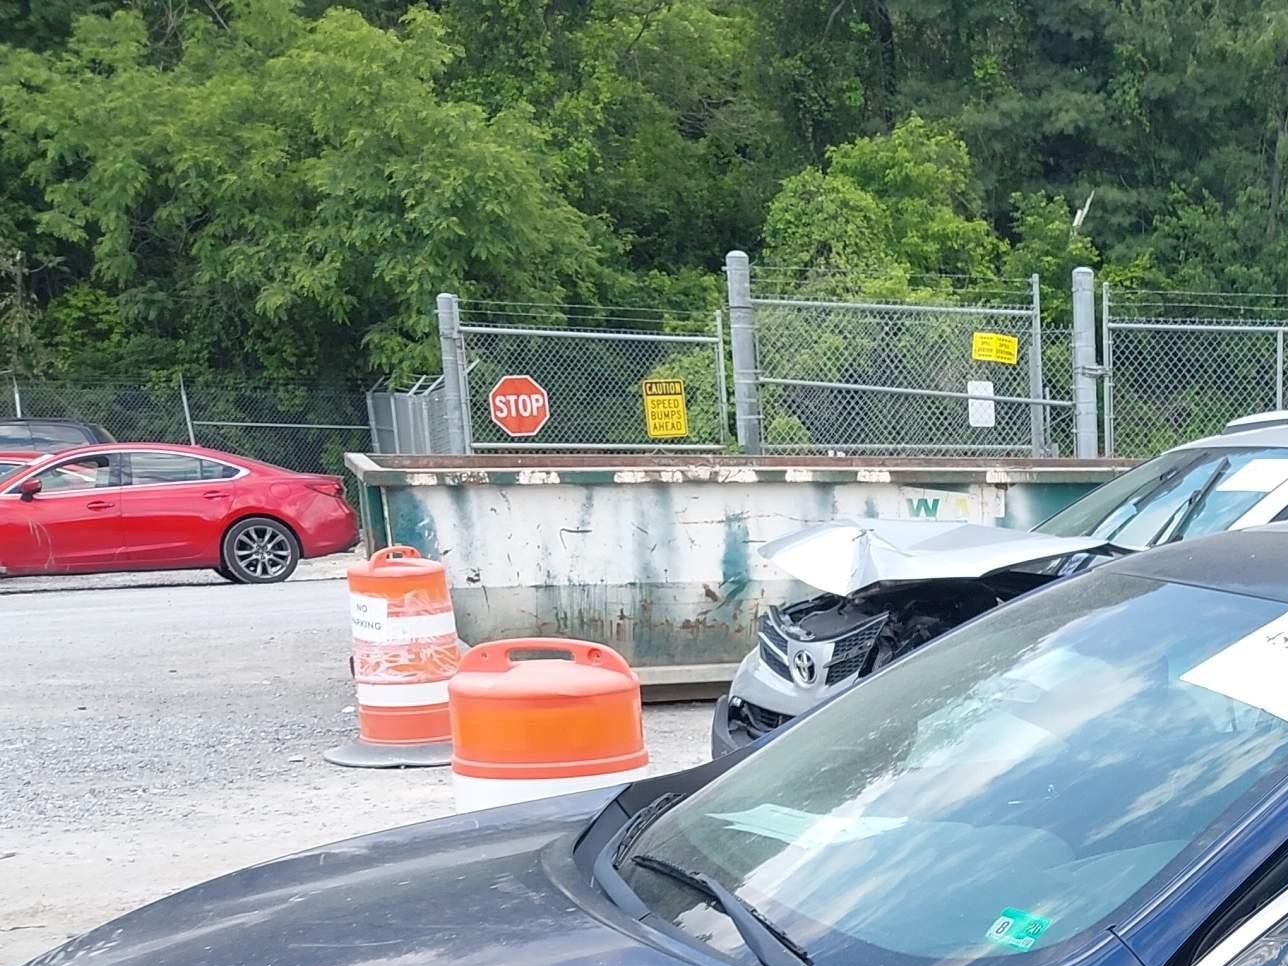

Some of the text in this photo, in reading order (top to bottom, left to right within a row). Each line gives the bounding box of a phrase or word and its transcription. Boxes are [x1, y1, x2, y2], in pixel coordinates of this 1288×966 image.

[646, 382, 681, 395] CAUTION
[494, 394, 543, 418] STOP
[650, 399, 679, 409] SPEED
[651, 410, 682, 420] BUMPS
[653, 421, 682, 432] AHEAD
[356, 602, 368, 613] NO
[995, 920, 1010, 935] 8
